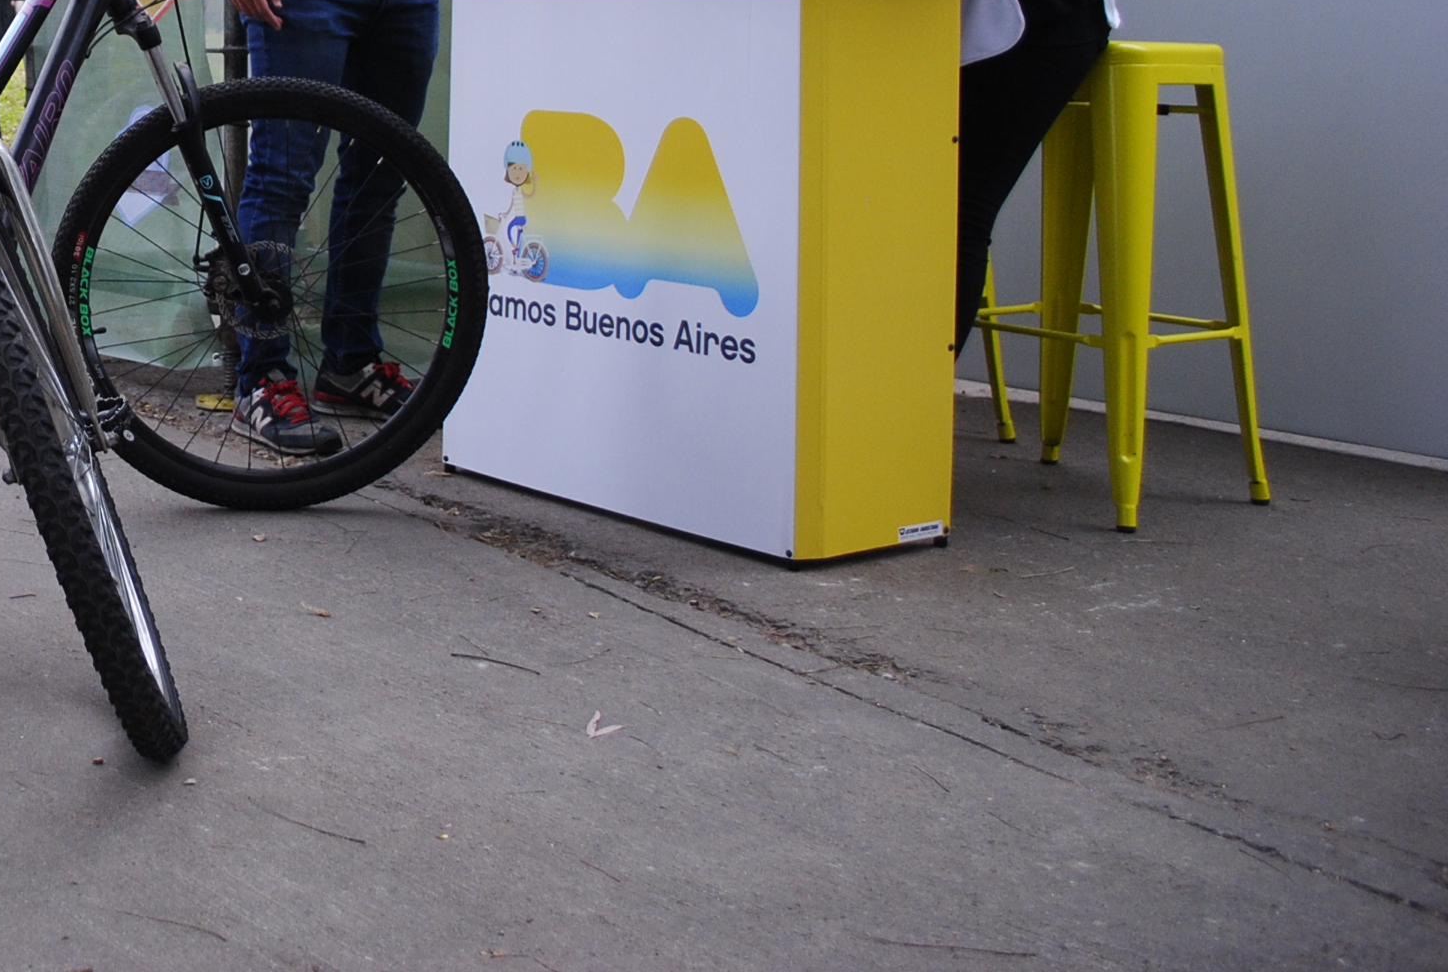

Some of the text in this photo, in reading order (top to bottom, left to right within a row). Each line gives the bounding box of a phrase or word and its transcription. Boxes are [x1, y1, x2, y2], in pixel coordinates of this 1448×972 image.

[520, 109, 760, 317] BA
[79, 245, 95, 337] BLACK BOX
[442, 258, 459, 349] BLACK BOX
[489, 293, 757, 365] amos Buenos Aires
